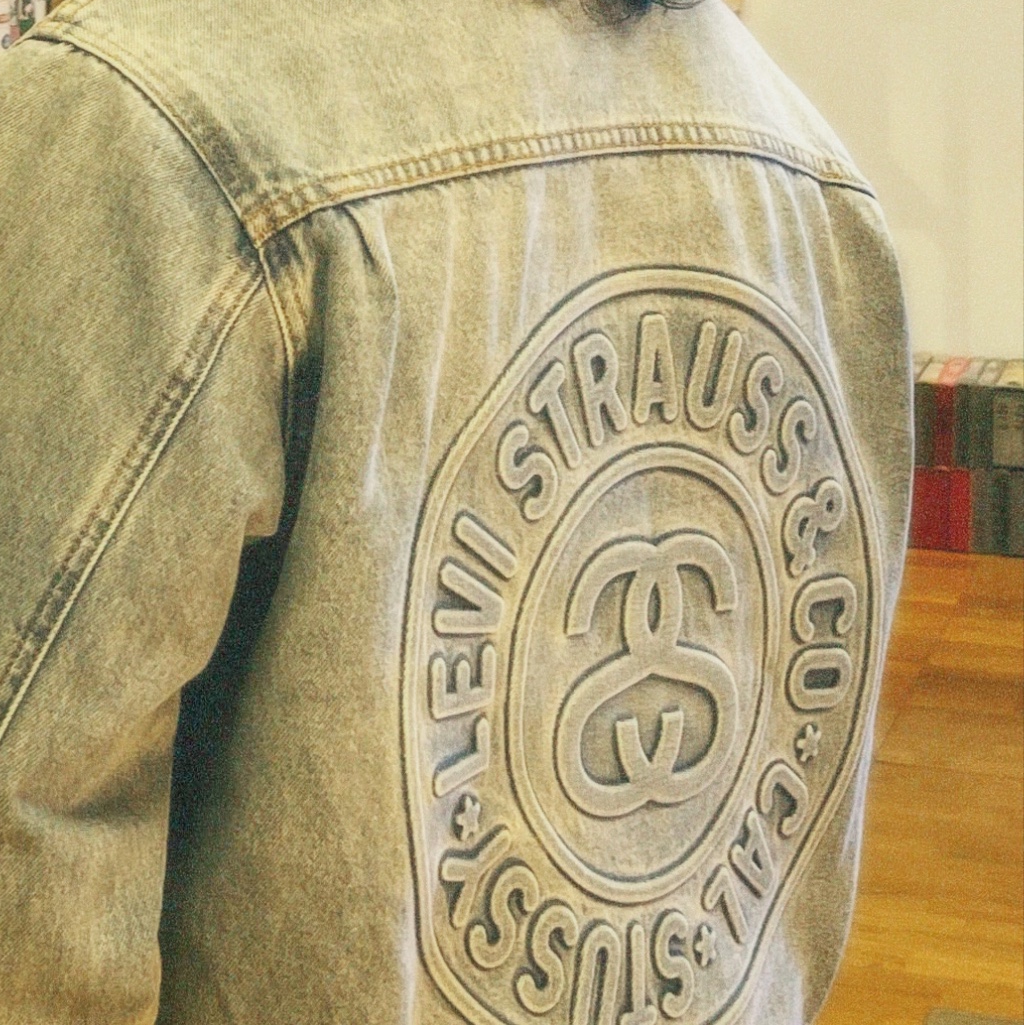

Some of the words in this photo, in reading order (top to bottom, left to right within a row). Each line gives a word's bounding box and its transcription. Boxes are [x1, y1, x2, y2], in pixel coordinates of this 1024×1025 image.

[494, 310, 817, 523] STRAUSS
[780, 476, 846, 577] &
[788, 574, 858, 713] CO
[705, 756, 810, 945] CAL
